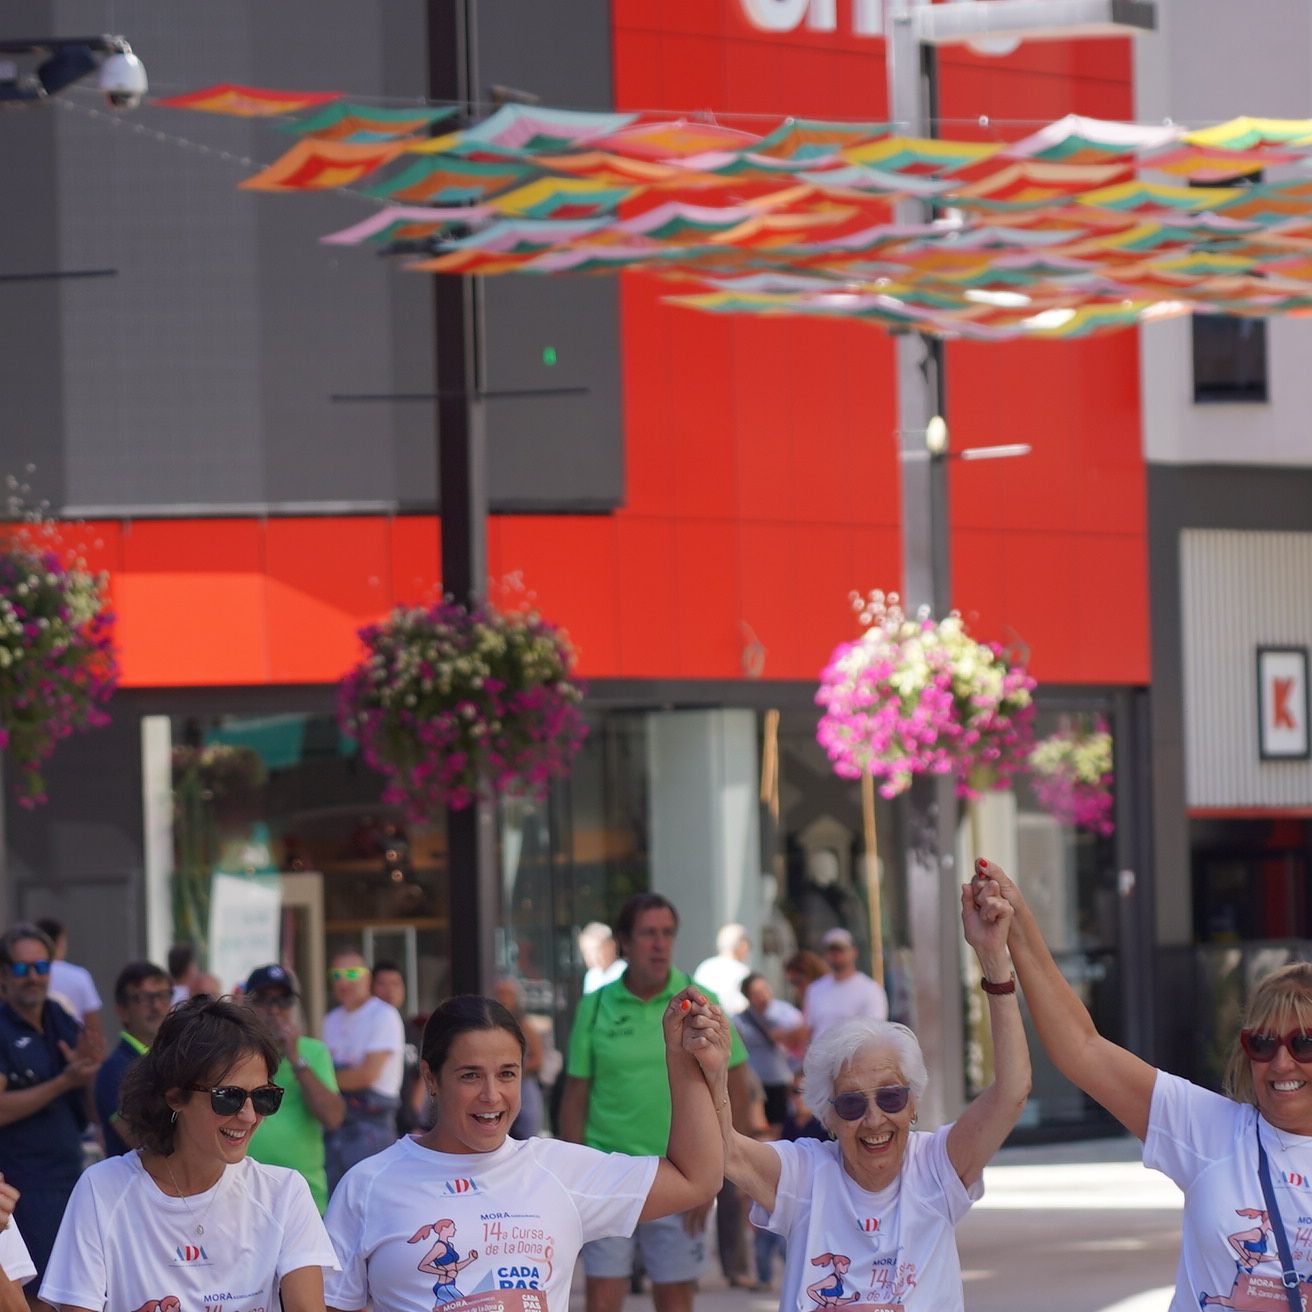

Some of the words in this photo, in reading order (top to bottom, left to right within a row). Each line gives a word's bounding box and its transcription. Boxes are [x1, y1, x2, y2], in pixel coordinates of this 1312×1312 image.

[480, 1212, 510, 1221] MORA
[511, 1226, 544, 1241] Cursa
[485, 1243, 499, 1256] de
[517, 1240, 543, 1256] Dona
[497, 1266, 540, 1279] CADA
[1249, 1278, 1274, 1289] MORA
[202, 1291, 233, 1303] MORA
[443, 1300, 468, 1312] MORA
[523, 1301, 542, 1310] PAS
